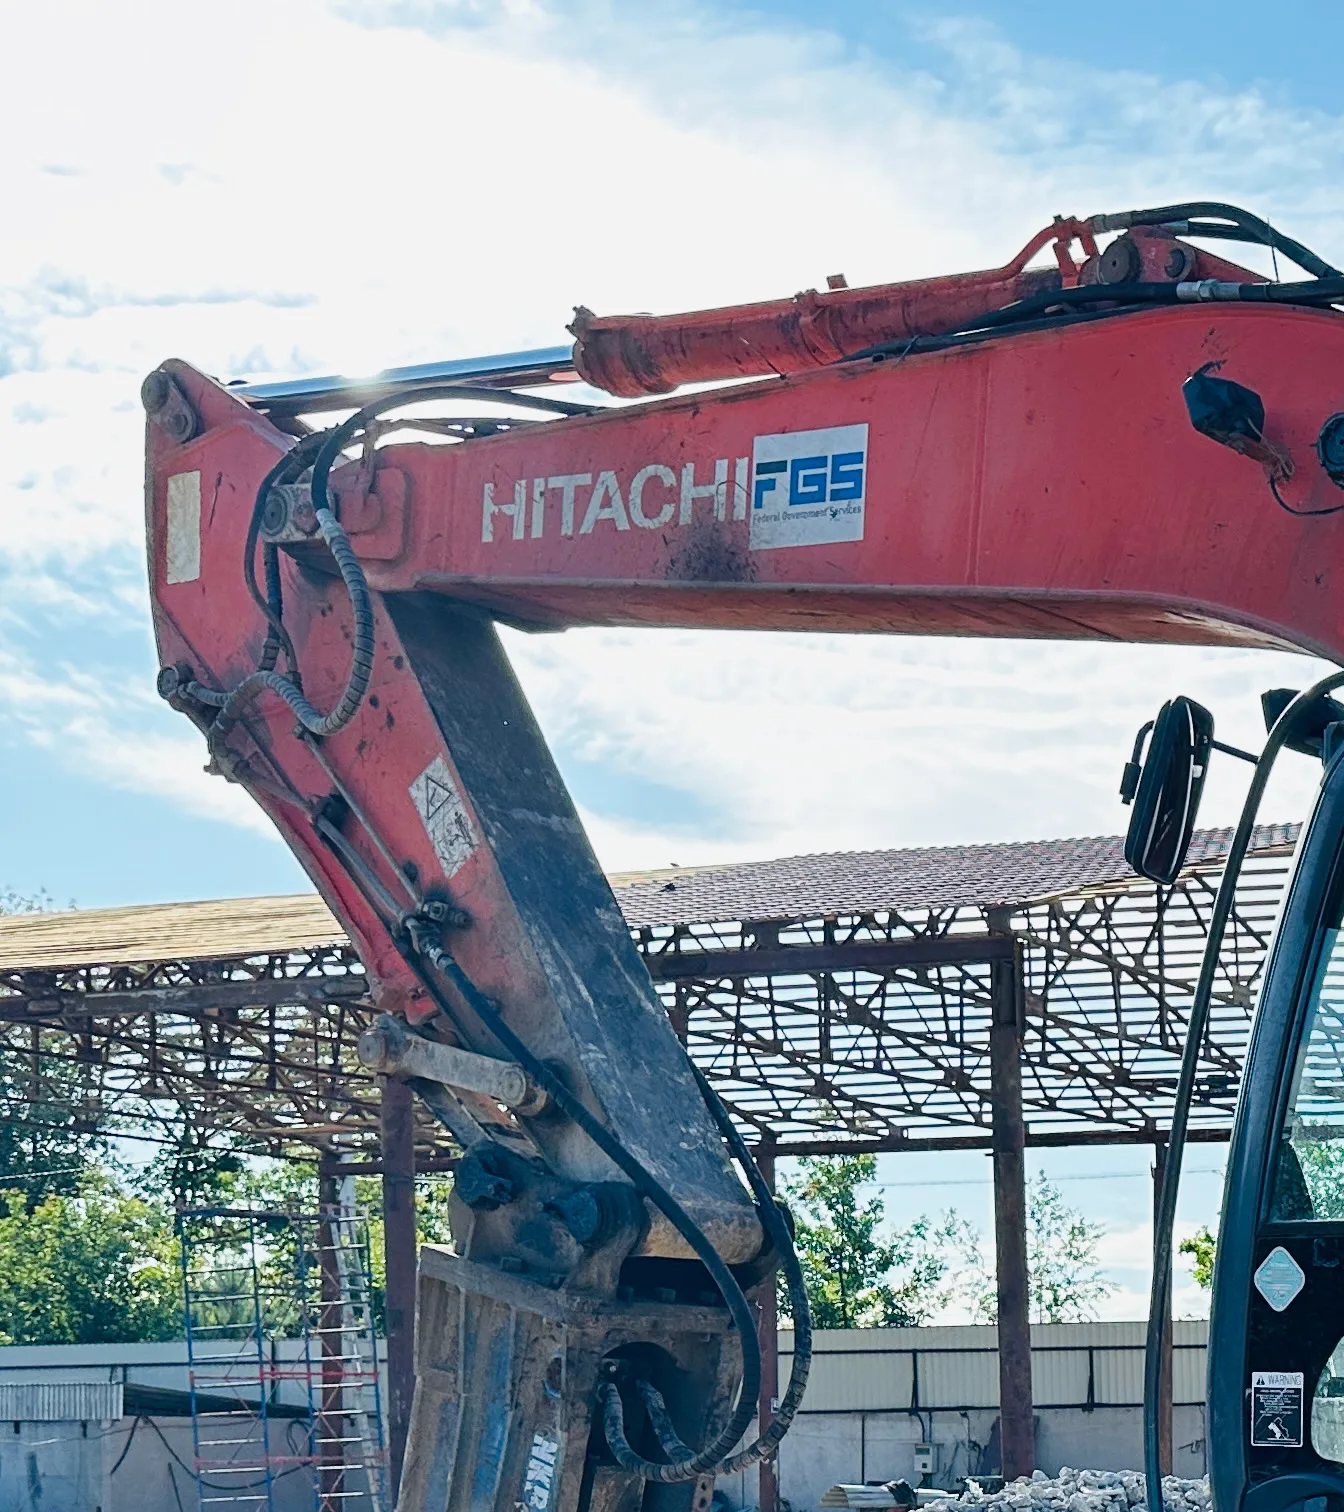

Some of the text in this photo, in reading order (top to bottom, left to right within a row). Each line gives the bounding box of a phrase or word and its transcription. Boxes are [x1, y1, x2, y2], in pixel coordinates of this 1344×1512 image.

[754, 451, 864, 509] FGS
[481, 456, 749, 543] HITACHI
[752, 512, 781, 525] Federal
[1268, 1375, 1302, 1386] WARNING
